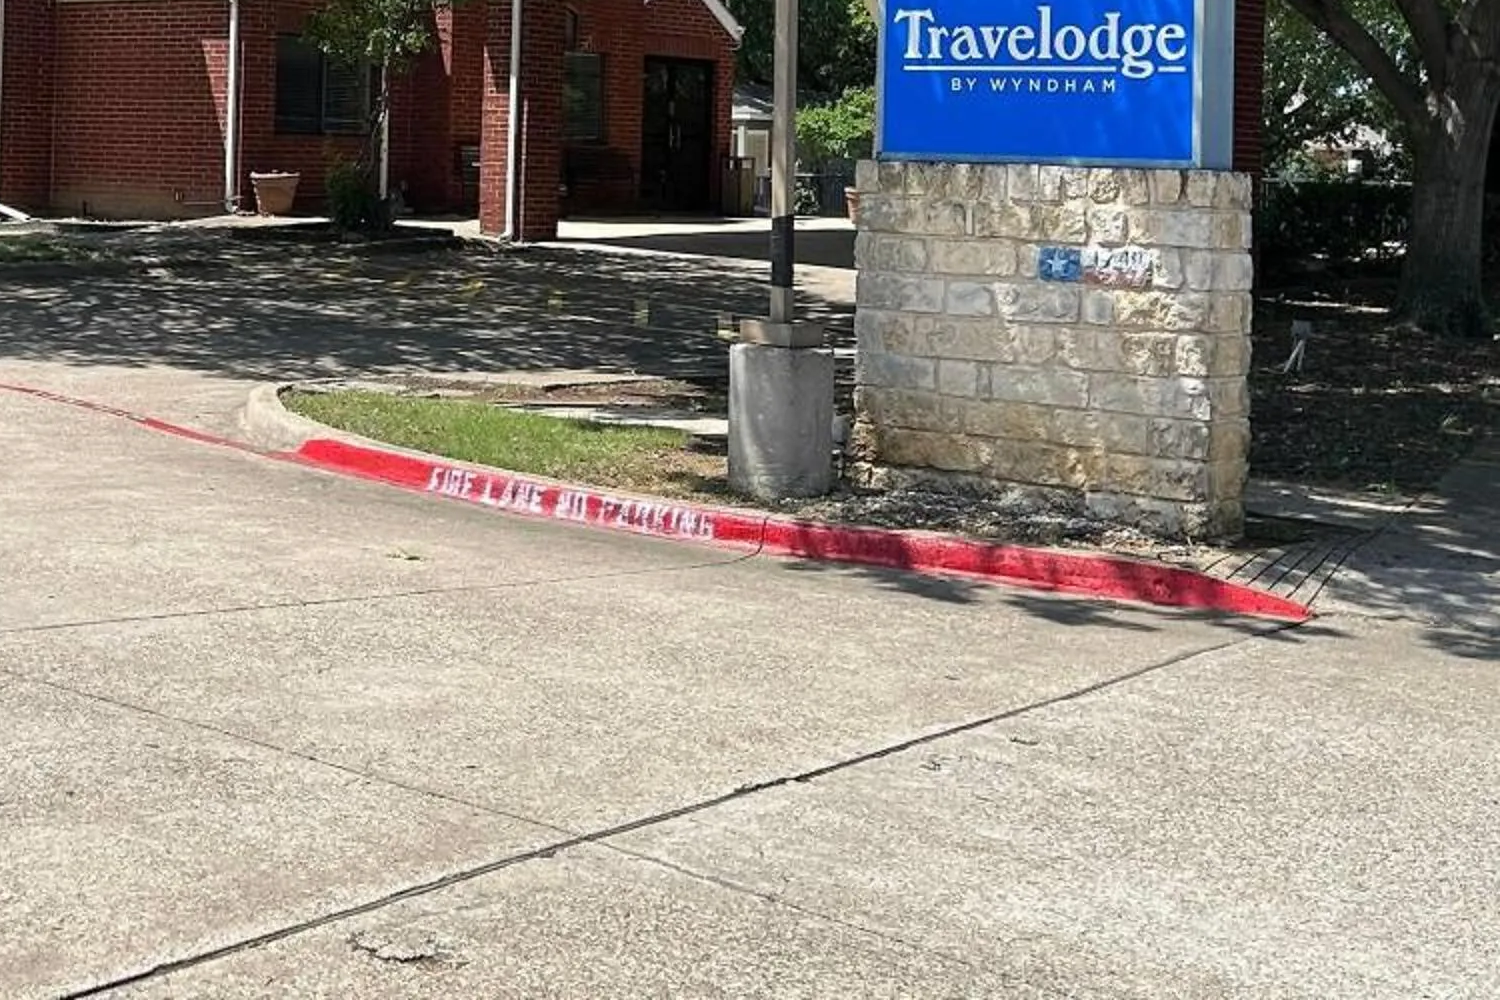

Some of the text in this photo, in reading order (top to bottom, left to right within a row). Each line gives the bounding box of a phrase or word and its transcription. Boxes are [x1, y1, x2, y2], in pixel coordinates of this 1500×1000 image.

[893, 5, 1188, 79] Travelodge
[950, 77, 1117, 93] BY WYNDHAM
[426, 466, 477, 500] FIRE
[480, 475, 547, 513] LANE
[601, 499, 714, 541] PARKING
